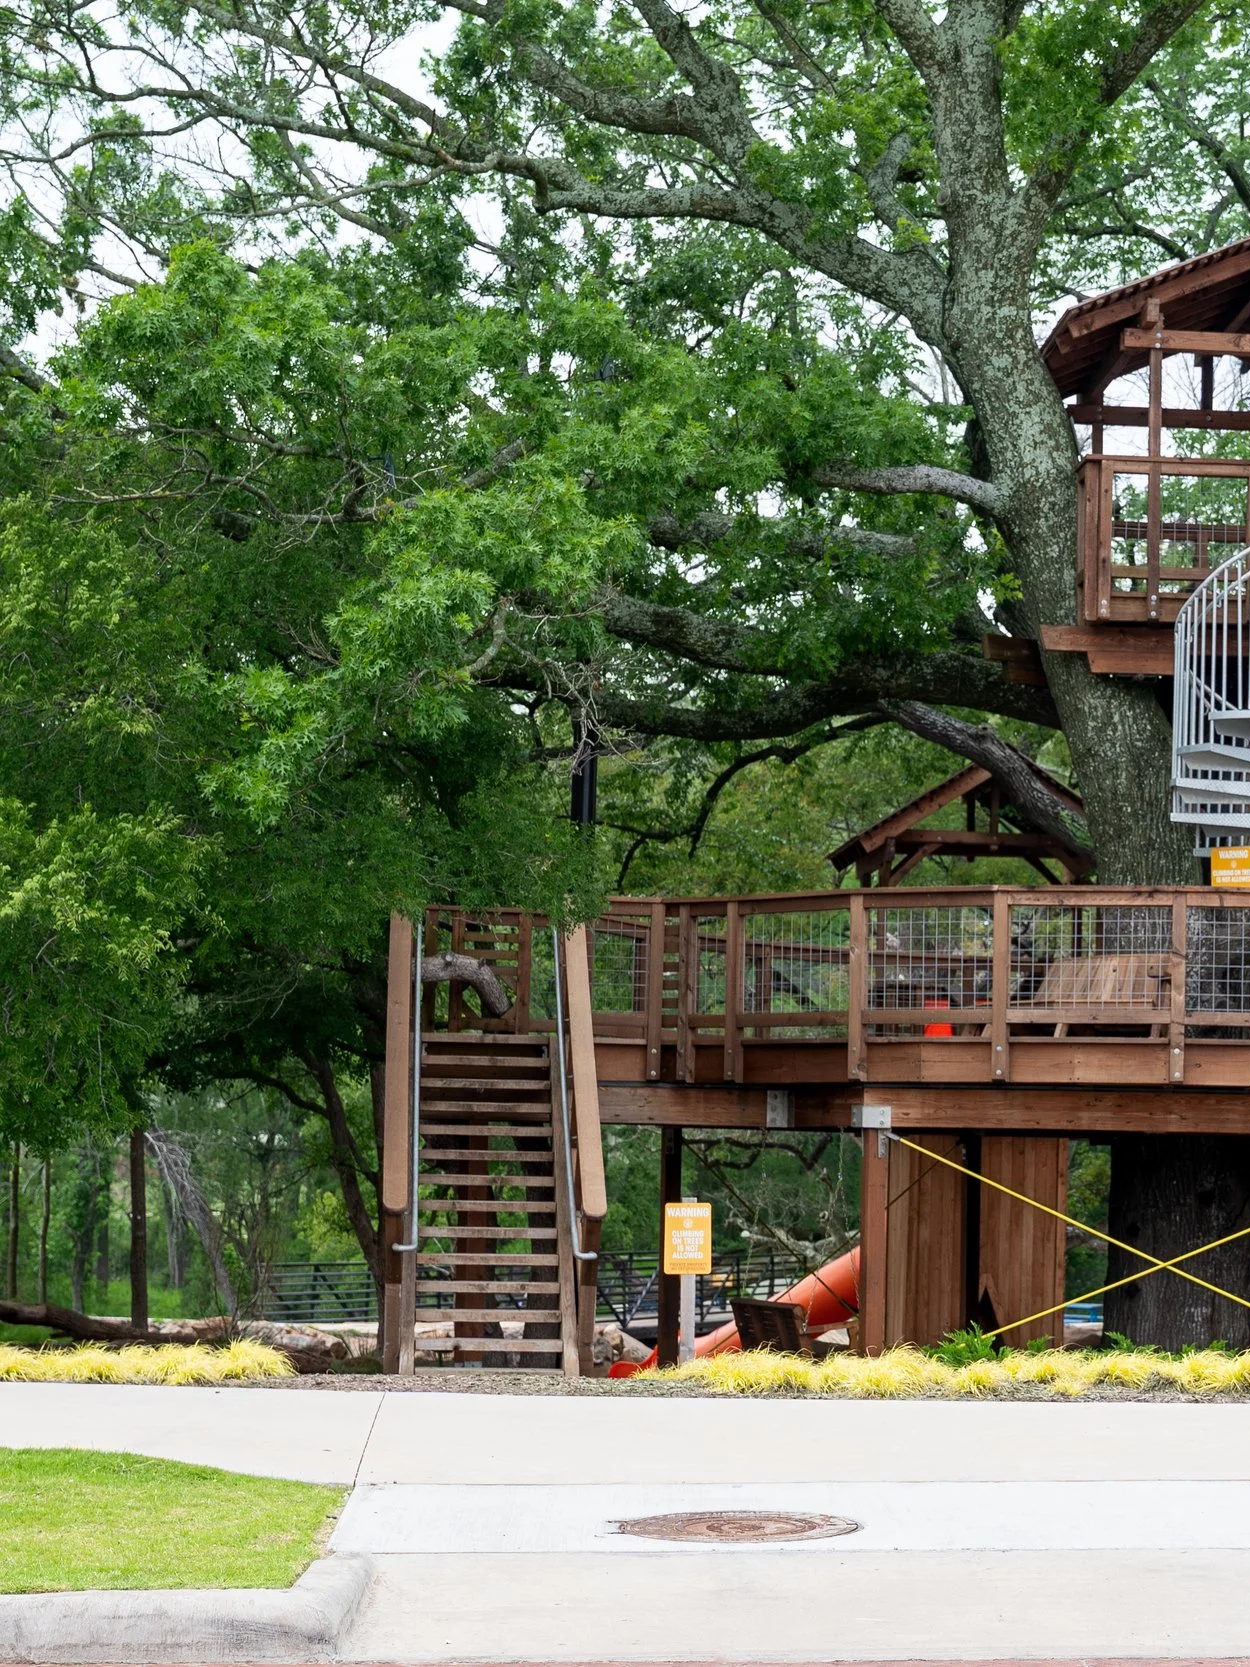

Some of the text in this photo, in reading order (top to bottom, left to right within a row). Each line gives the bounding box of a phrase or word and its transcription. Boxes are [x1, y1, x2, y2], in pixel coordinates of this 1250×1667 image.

[1219, 850, 1248, 859] WARNING
[667, 1207, 709, 1217] WARNING
[672, 1230, 704, 1238] CLIMBING
[672, 1237, 704, 1245] ON TREES
[677, 1244, 698, 1252] IS NOT
[672, 1251, 704, 1259] ALLOWED
